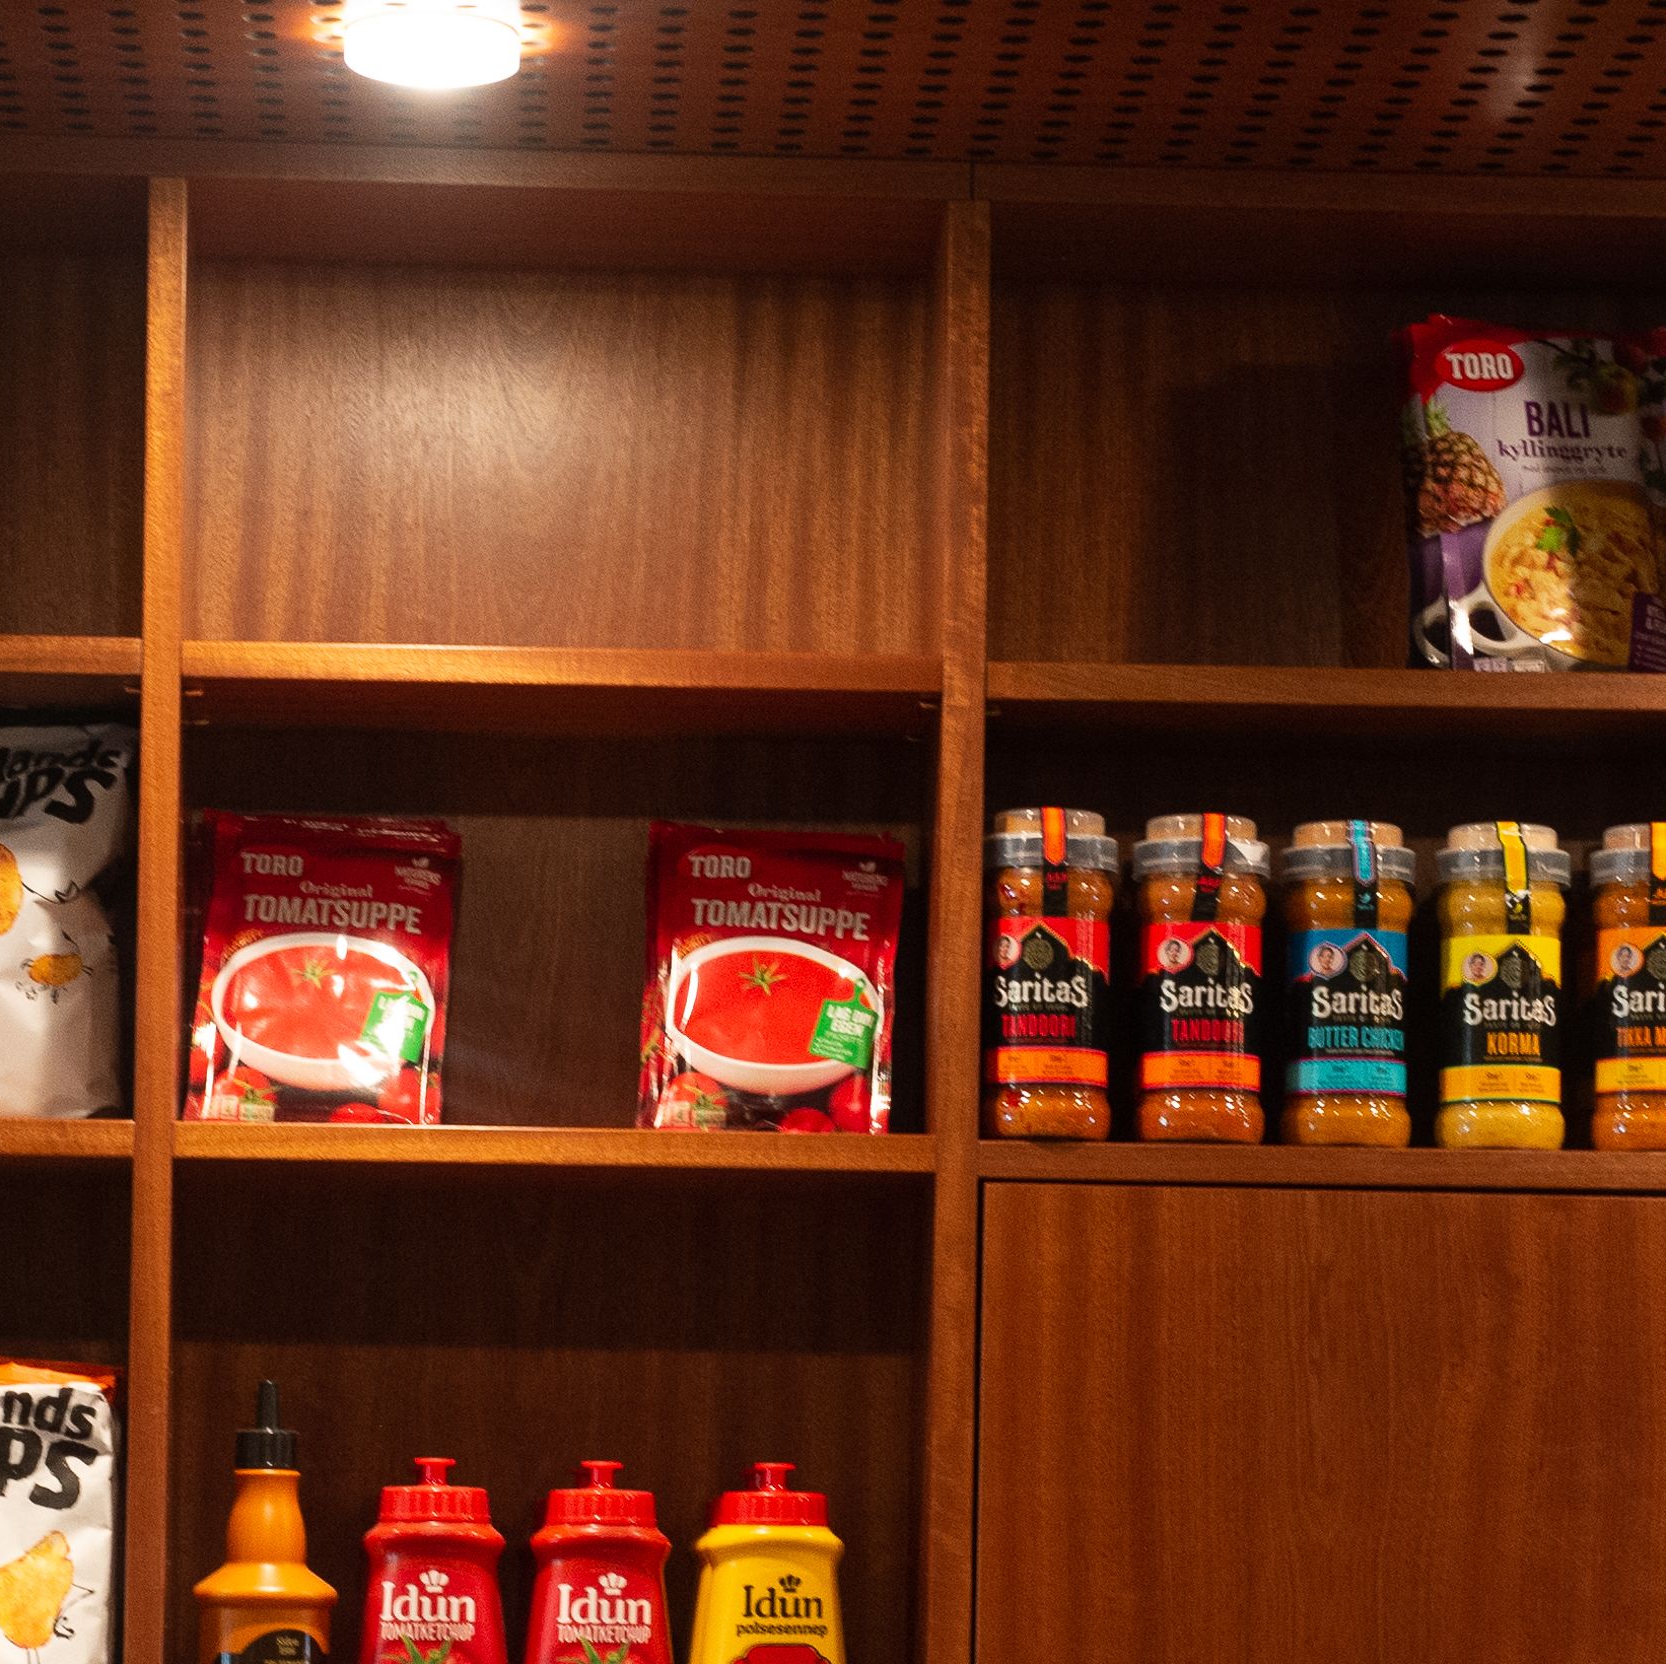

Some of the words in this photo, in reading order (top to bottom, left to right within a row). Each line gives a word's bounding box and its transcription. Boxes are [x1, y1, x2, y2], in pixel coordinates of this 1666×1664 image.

[1446, 351, 1514, 381] TORO
[1525, 400, 1591, 438] BALI
[1498, 433, 1627, 466] kyllinggryte
[241, 851, 304, 877] TORO
[688, 854, 752, 879] TORO
[300, 880, 373, 900] Original
[747, 882, 822, 902] Original
[243, 894, 423, 935] TOMATSUPPE
[691, 897, 870, 941] TOMATSUPPE
[1001, 1013, 1076, 1038] TANDOORI
[1487, 1032, 1541, 1056] KORMA
[380, 1581, 477, 1623] Idun
[556, 1583, 652, 1625] Idun
[742, 1584, 823, 1619] Idun
